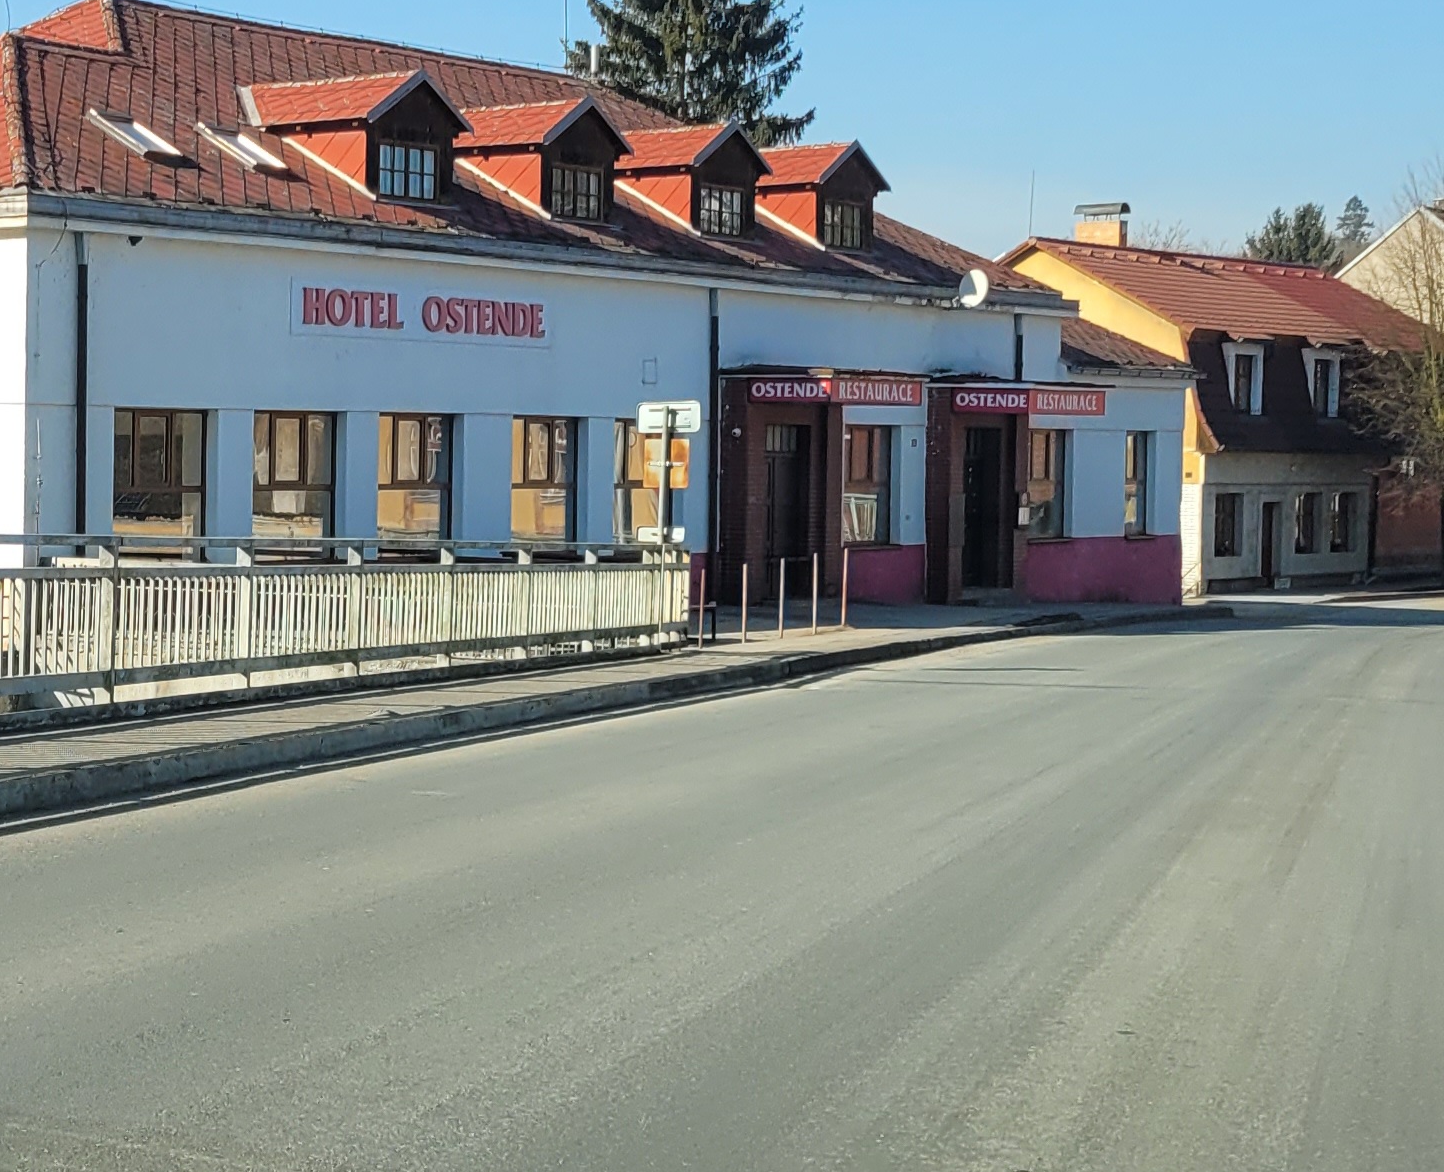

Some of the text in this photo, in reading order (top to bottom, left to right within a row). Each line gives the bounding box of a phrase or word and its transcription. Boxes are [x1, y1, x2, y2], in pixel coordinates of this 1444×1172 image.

[302, 287, 546, 338] HOTEL OSTENDE
[838, 381, 913, 402] RESTAURACE
[956, 392, 1097, 411] OSTENDE RESTAURACE
